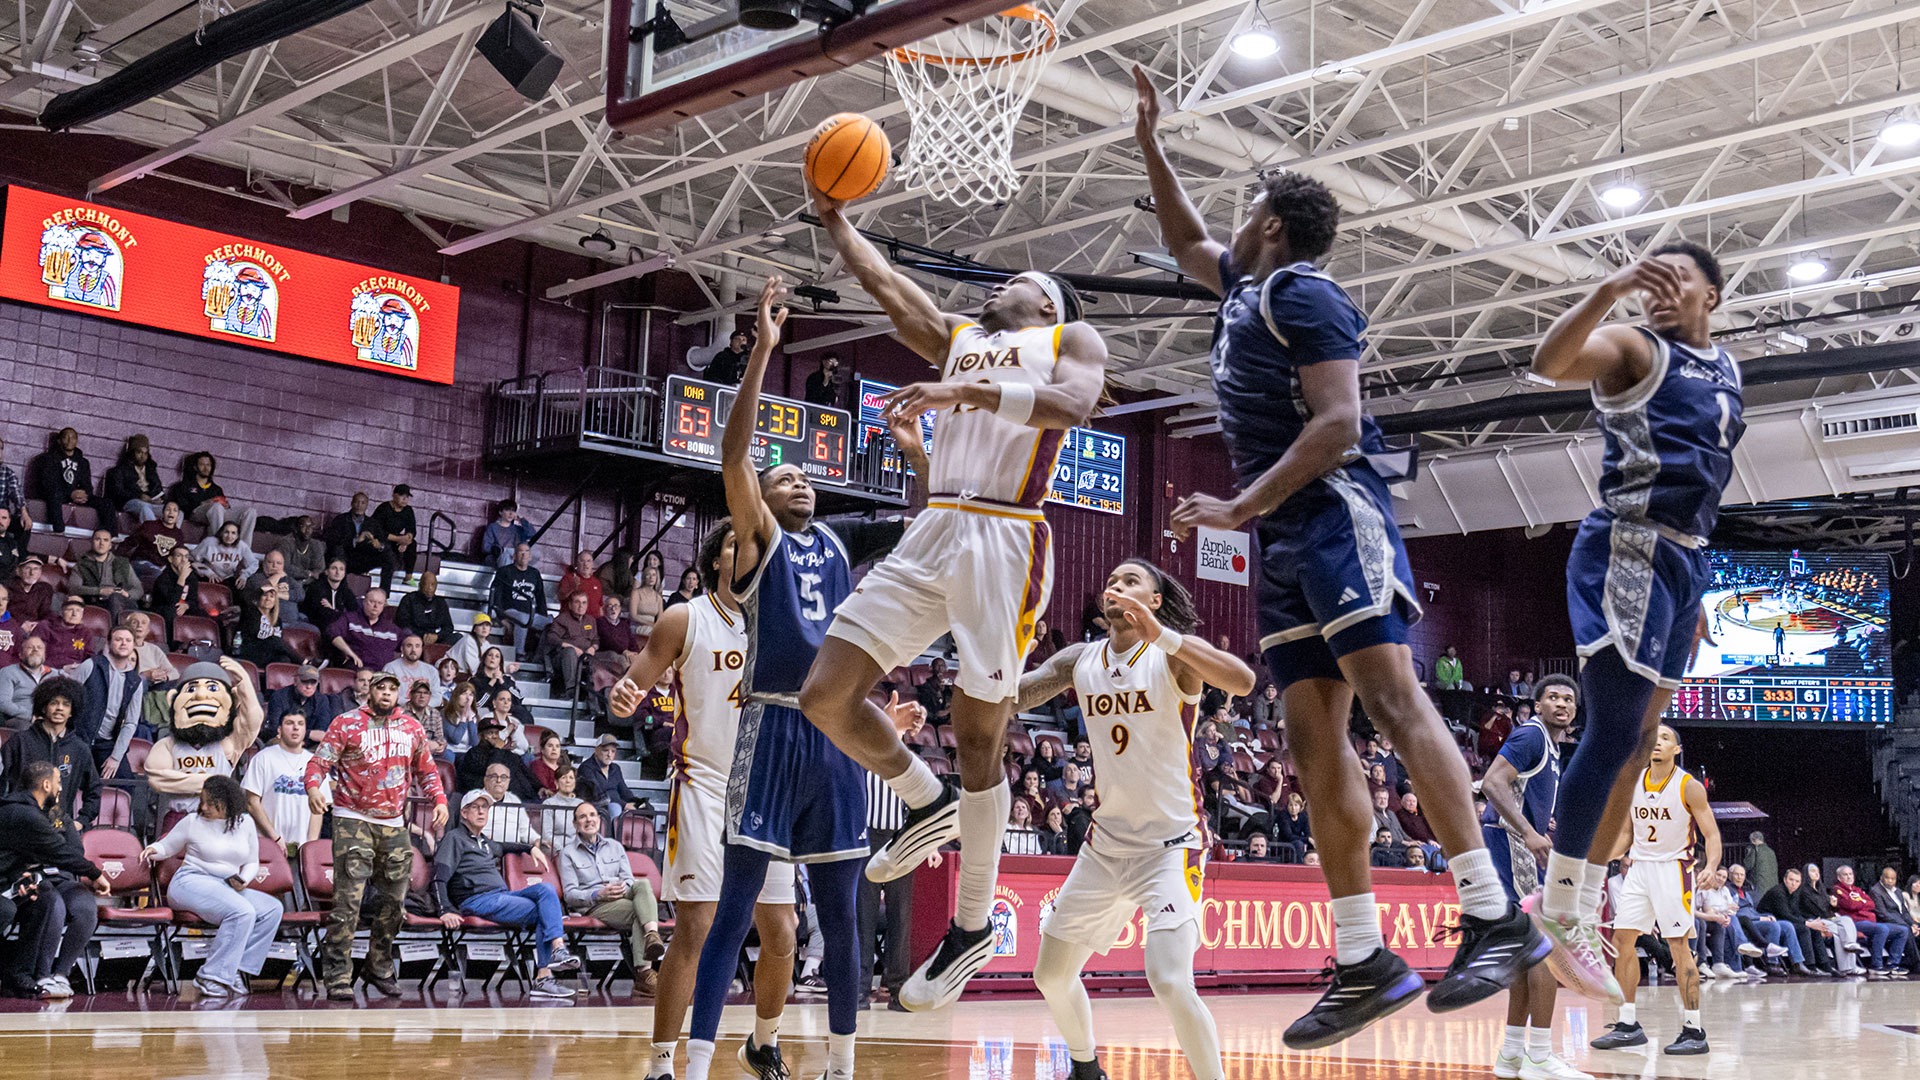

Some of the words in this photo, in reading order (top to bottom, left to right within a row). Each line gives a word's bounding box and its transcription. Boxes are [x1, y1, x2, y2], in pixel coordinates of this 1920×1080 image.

[42, 207, 138, 250] BEECHMONT
[204, 242, 291, 284] BEECHMONT
[351, 275, 430, 314] BEECHMONT
[949, 346, 1021, 377] IONA
[684, 385, 705, 400] IONA
[680, 403, 711, 438] 63
[820, 413, 837, 427] SPU
[1716, 391, 1731, 448] 1
[687, 441, 715, 456] BONUS
[769, 443, 783, 466] 3
[815, 430, 844, 463] 61
[1101, 441, 1120, 460] 39
[802, 462, 828, 477] BONUS
[1101, 473, 1119, 493] 32
[655, 491, 686, 506] SCTION
[1078, 494, 1091, 506] 2H
[664, 505, 676, 521] 5
[1170, 539, 1177, 554] 6
[1201, 537, 1233, 557] Apple
[211, 552, 241, 563] IONA
[1200, 552, 1229, 571] Bank
[799, 572, 827, 621] 5
[1429, 590, 1434, 602] 7
[1726, 688, 1746, 701] 63
[1762, 689, 1794, 702] 3:33
[1804, 689, 1820, 703] 61
[1086, 690, 1154, 717] IONA
[1771, 711, 1778, 719] 3
[1796, 711, 1807, 719] 10
[1812, 712, 1819, 720] 2
[1110, 723, 1130, 755] 9
[177, 756, 215, 769] IONA
[1634, 806, 1671, 820] IONA
[1647, 826, 1656, 842] 2
